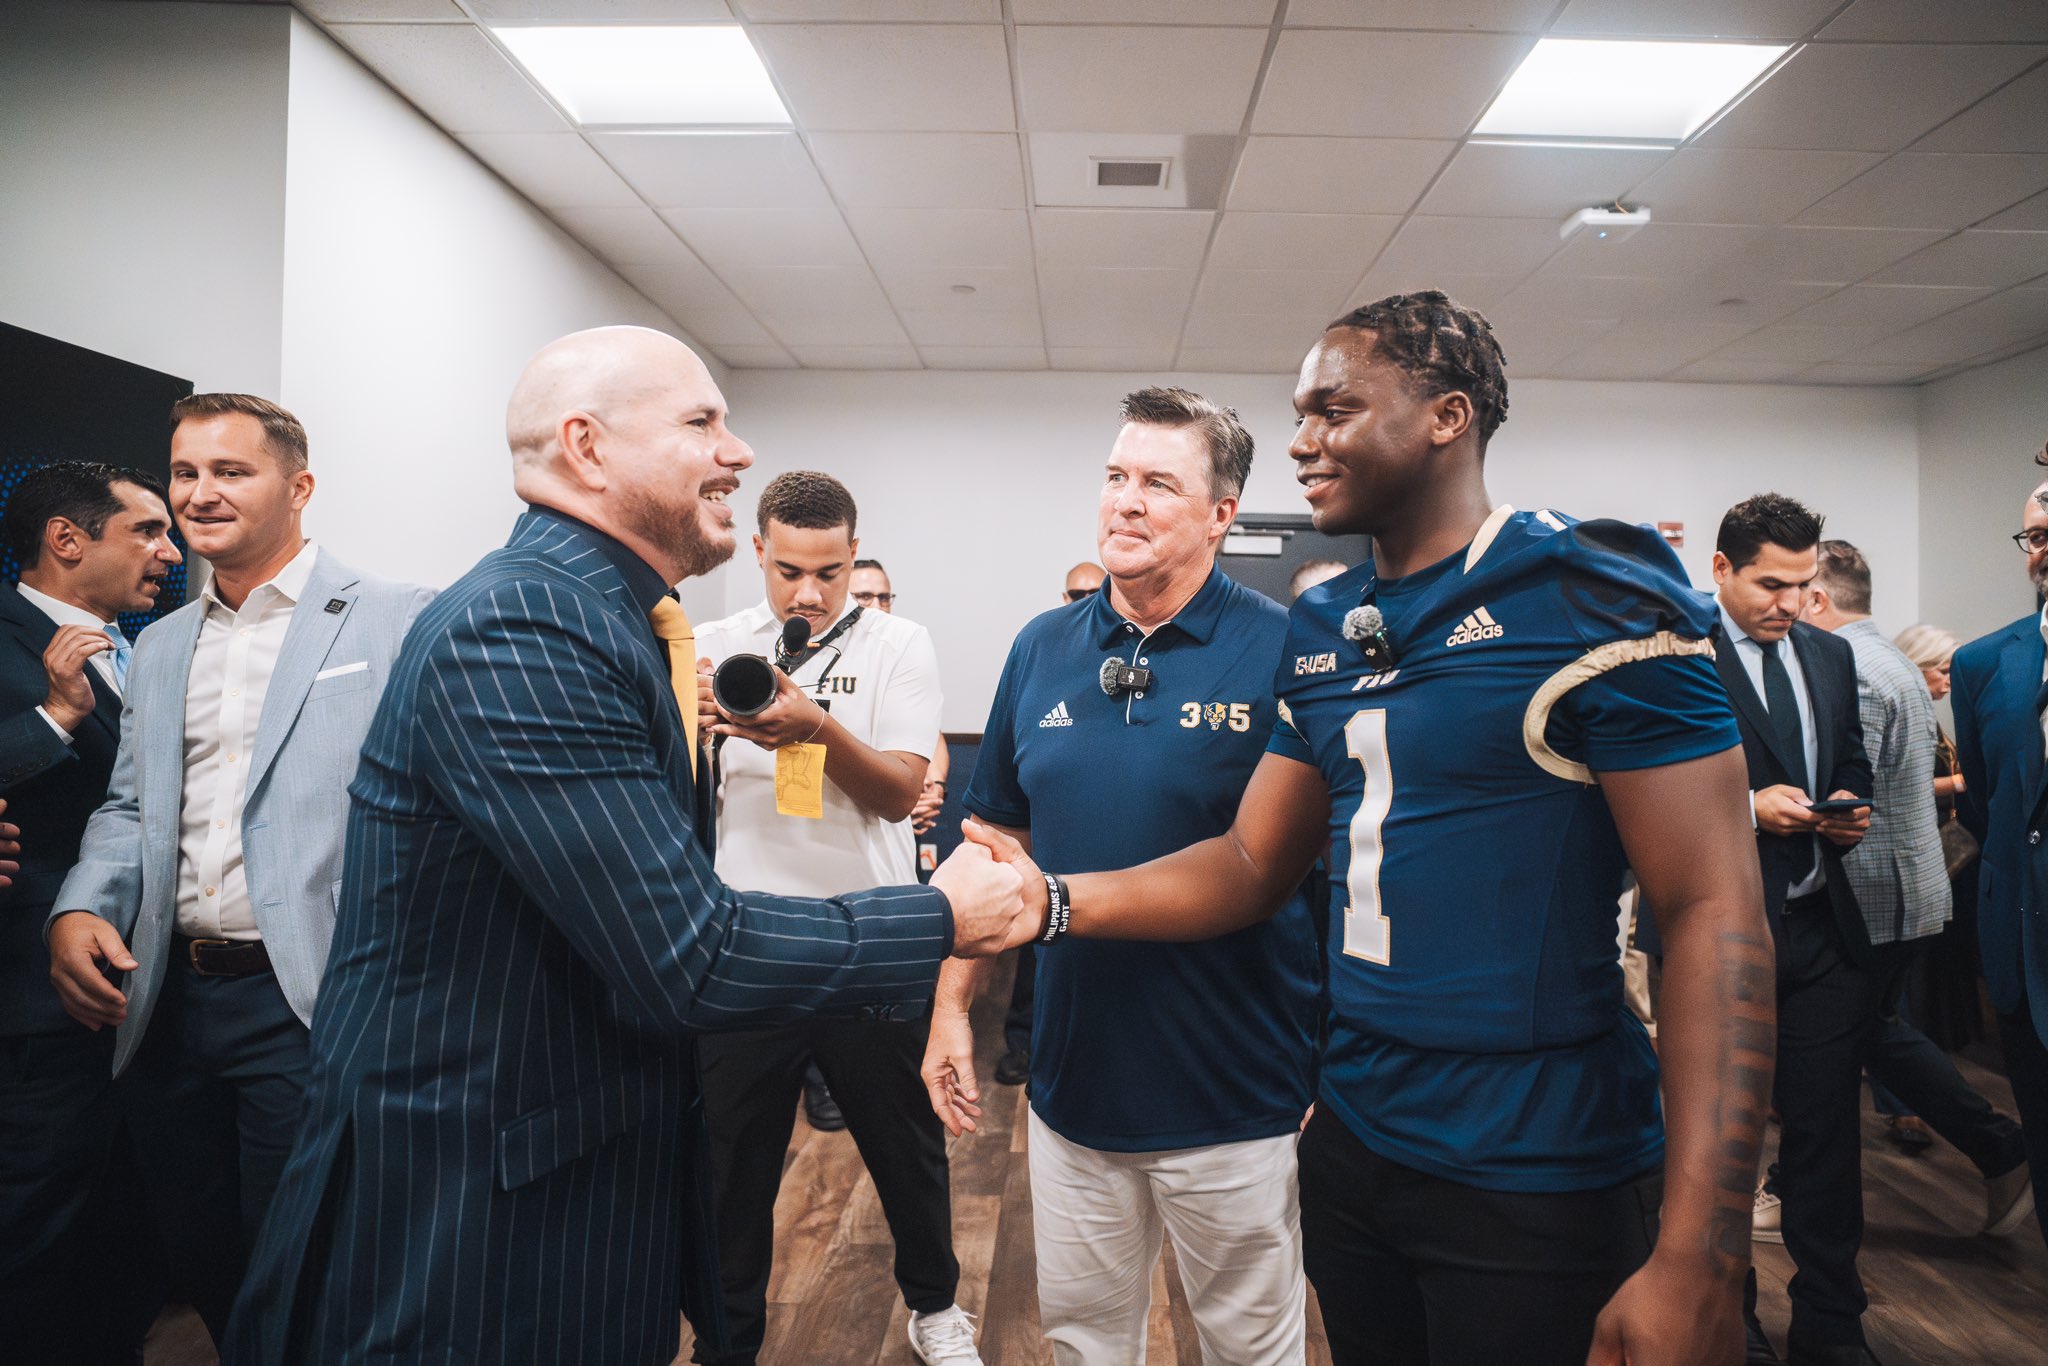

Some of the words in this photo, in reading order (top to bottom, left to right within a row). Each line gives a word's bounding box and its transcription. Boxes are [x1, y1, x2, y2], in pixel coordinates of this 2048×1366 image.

[1446, 625, 1504, 647] adidas
[815, 676, 857, 694] FIU
[1039, 717, 1073, 728] adidas
[1343, 708, 1394, 966] 1
[1043, 892, 1061, 941] PHILIPPIANS
